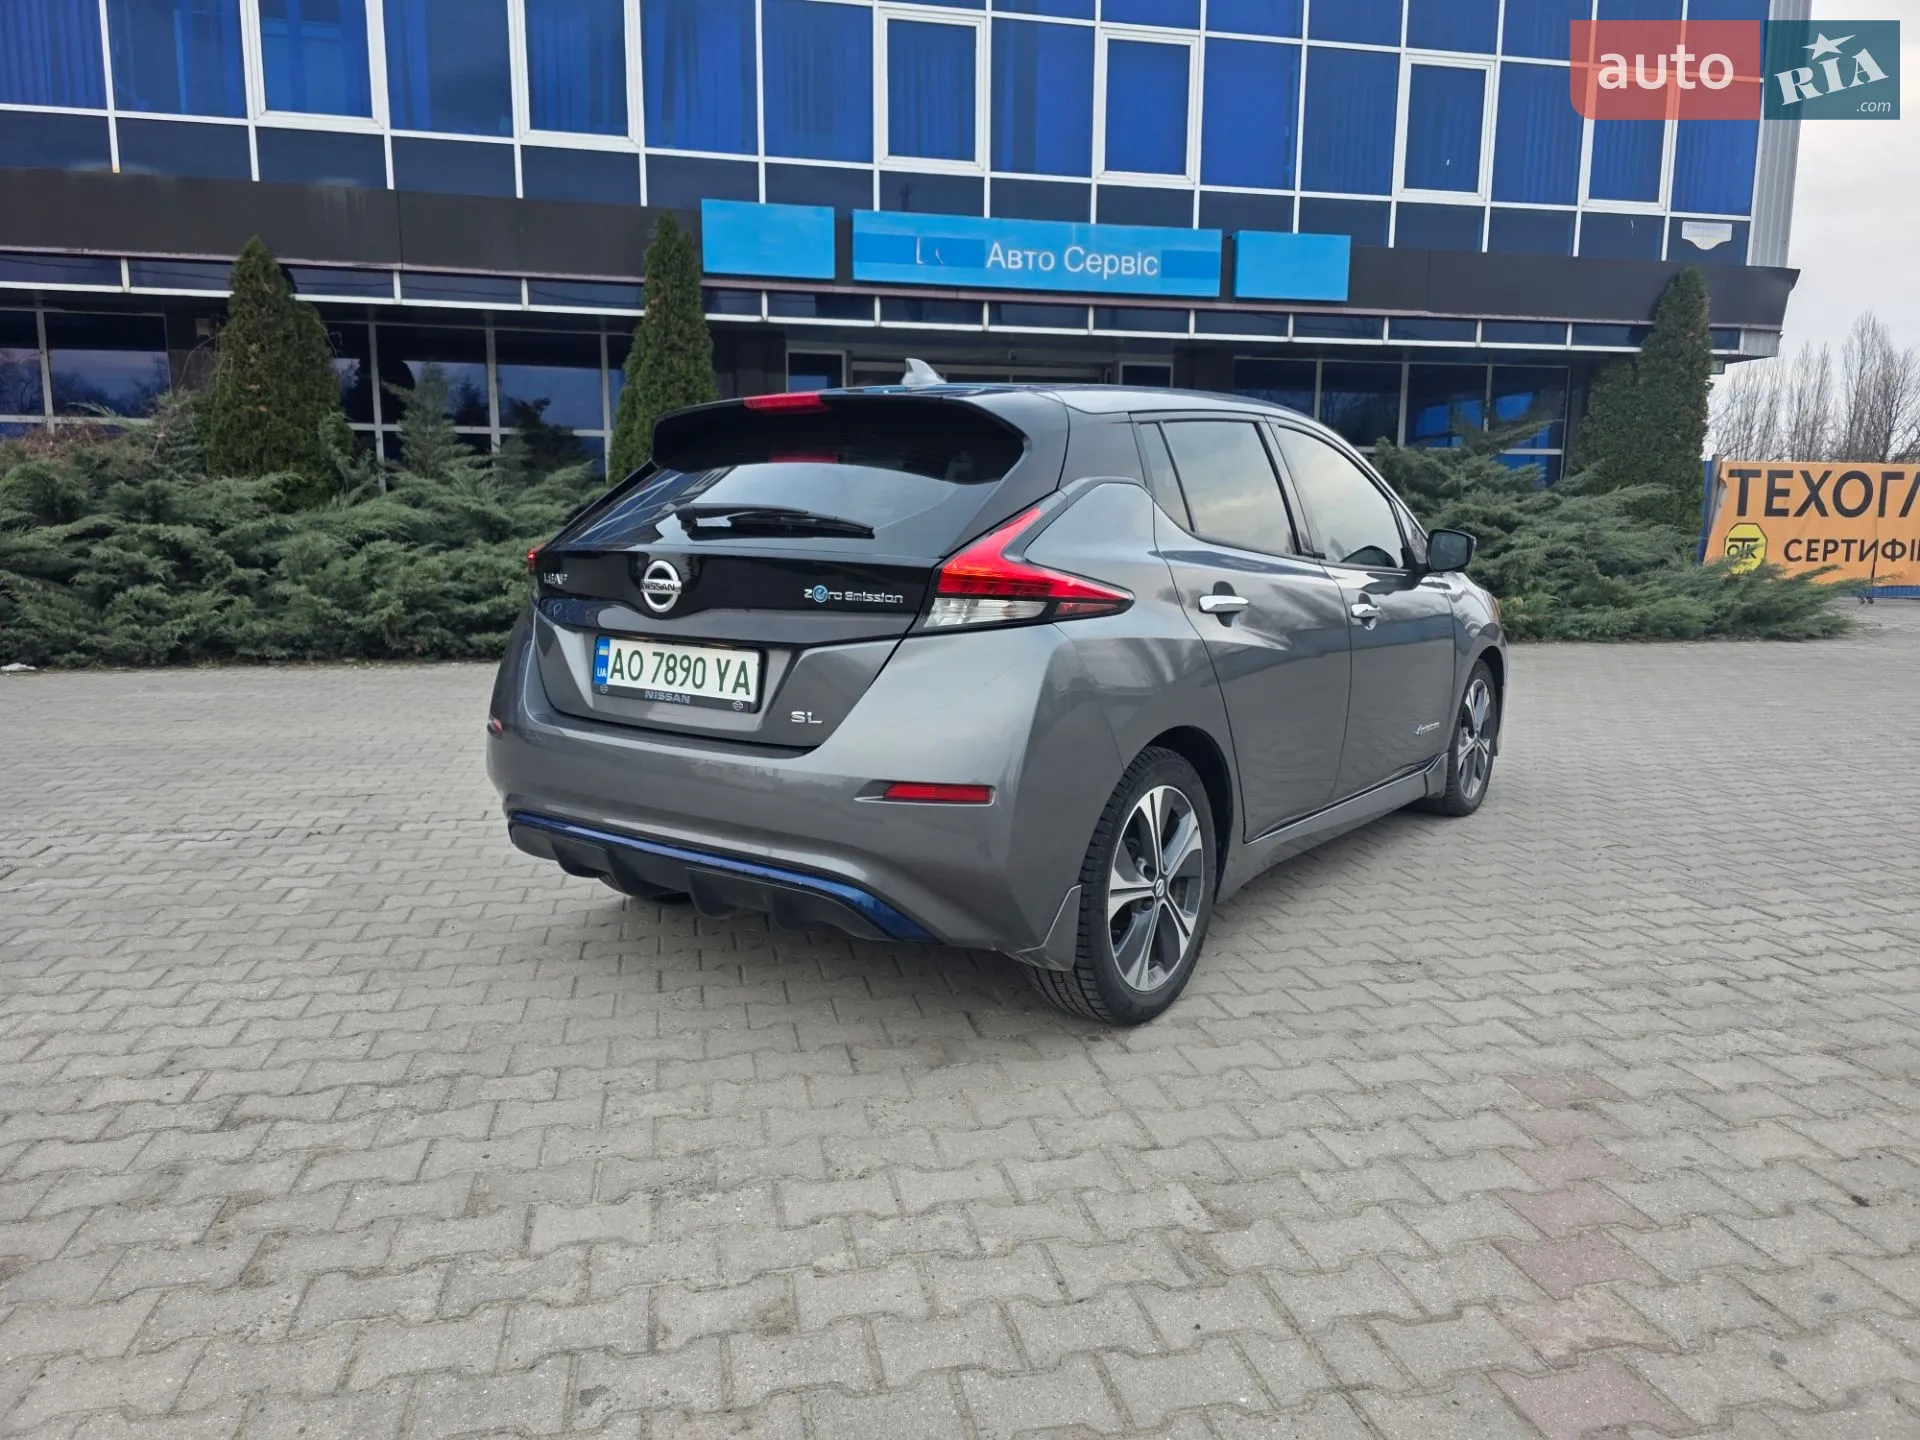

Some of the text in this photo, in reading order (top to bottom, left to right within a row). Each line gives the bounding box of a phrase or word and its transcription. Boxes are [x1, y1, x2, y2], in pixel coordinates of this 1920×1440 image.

[986, 242, 1159, 280] Авто Сервіс
[1783, 538, 1920, 562] СЕРТИФІ
[642, 581, 676, 591] NISSAN
[597, 668, 607, 678] UA
[610, 648, 750, 696] AO 7890 YA
[645, 690, 691, 704] NISSAN
[791, 711, 823, 724] SL
